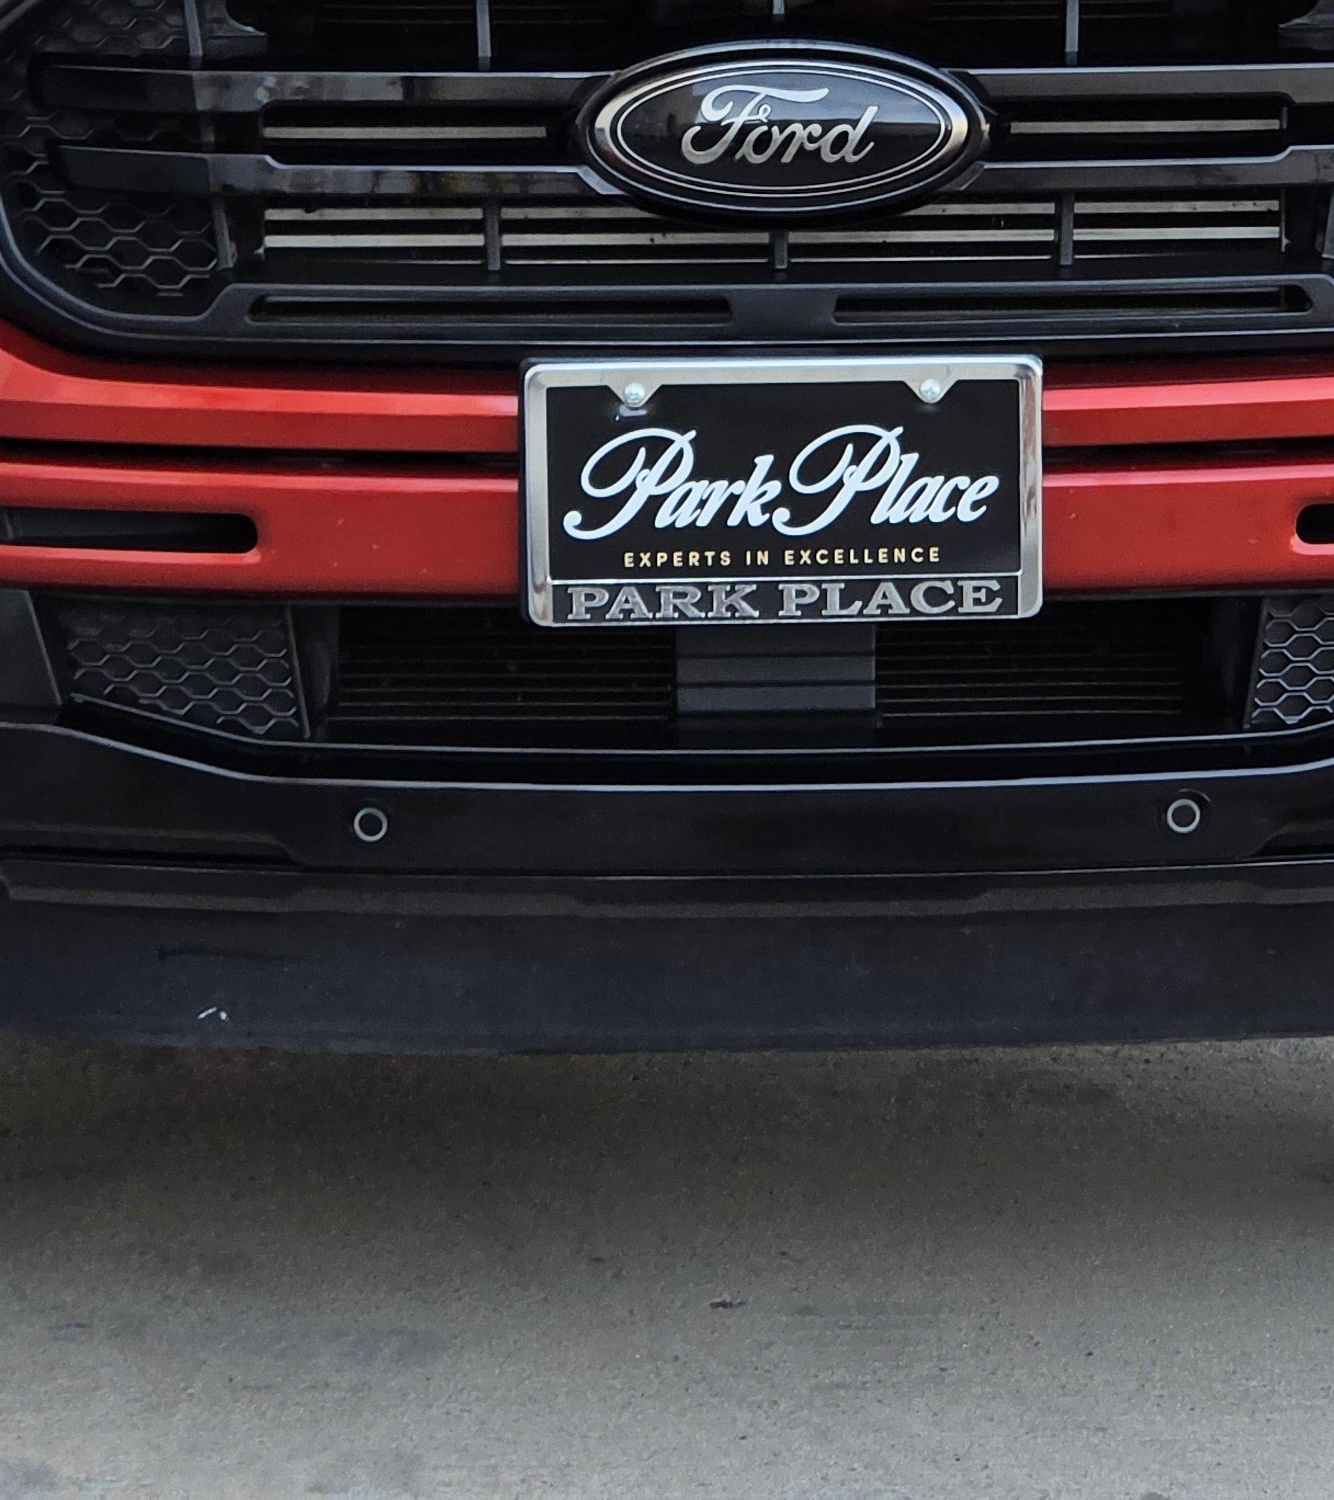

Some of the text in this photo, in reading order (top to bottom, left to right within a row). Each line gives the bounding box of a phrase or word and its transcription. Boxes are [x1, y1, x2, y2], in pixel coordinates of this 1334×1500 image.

[681, 84, 879, 165] Ford
[563, 424, 1000, 540] Park Place
[623, 546, 941, 568] EXPERTS IN EXCELLENCE
[566, 579, 1003, 620] PARK PLACE
